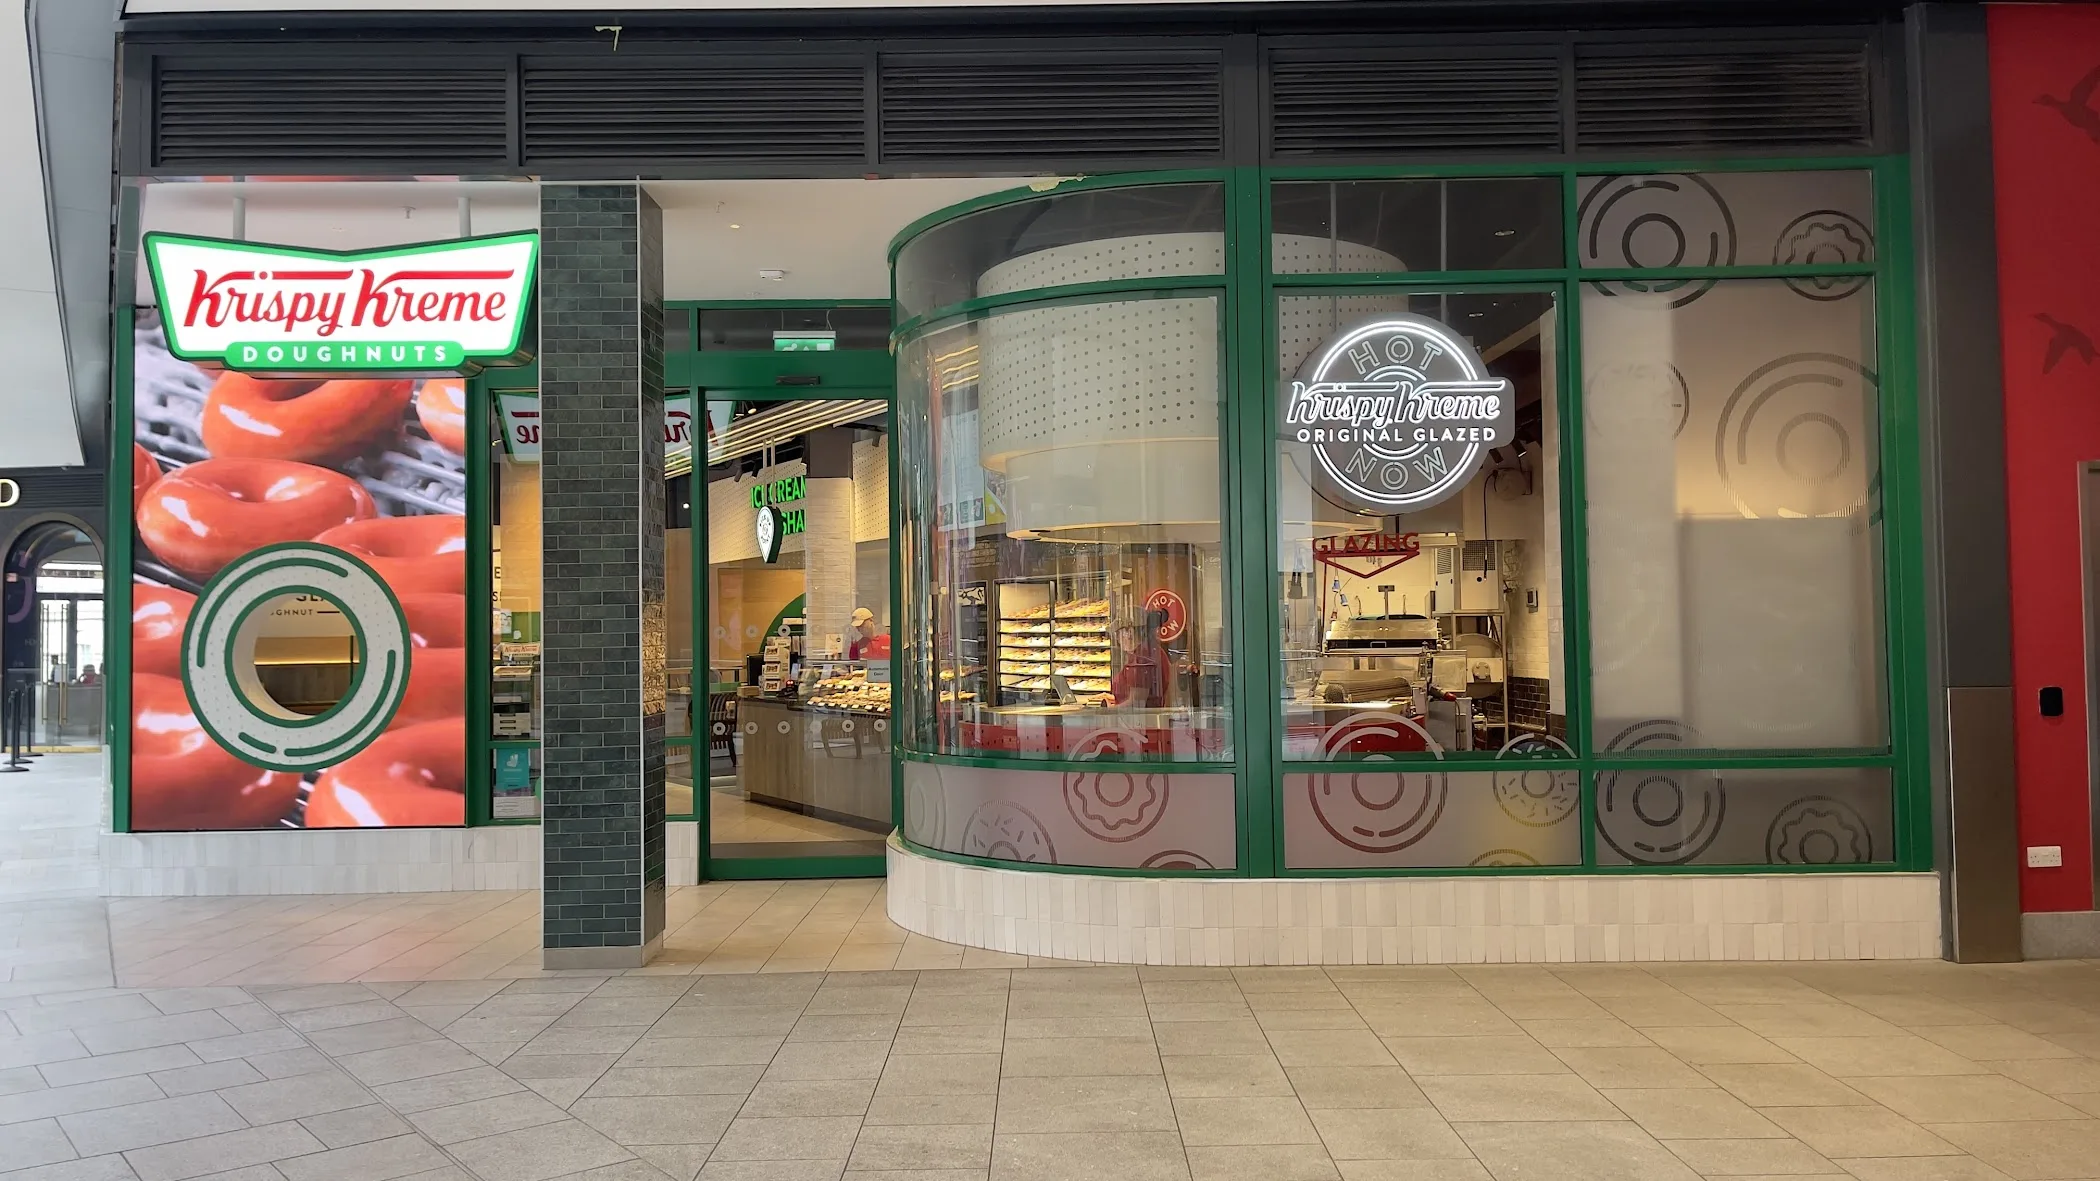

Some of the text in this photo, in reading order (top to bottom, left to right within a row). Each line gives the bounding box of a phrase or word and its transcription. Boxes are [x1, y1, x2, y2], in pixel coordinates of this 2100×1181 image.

[183, 268, 515, 337] Krispy Kreme
[242, 345, 447, 363] DOUGHNUTS
[1347, 334, 1443, 375] HOT
[1286, 379, 1506, 430] Krispy Kreme
[1296, 426, 1496, 443] ORIGINAL GLAZED
[1344, 446, 1449, 491] NOW
[781, 509, 807, 535] SHA
[1312, 532, 1420, 553] GLAZING
[1152, 596, 1175, 608] HOT
[1157, 619, 1179, 636] OW
